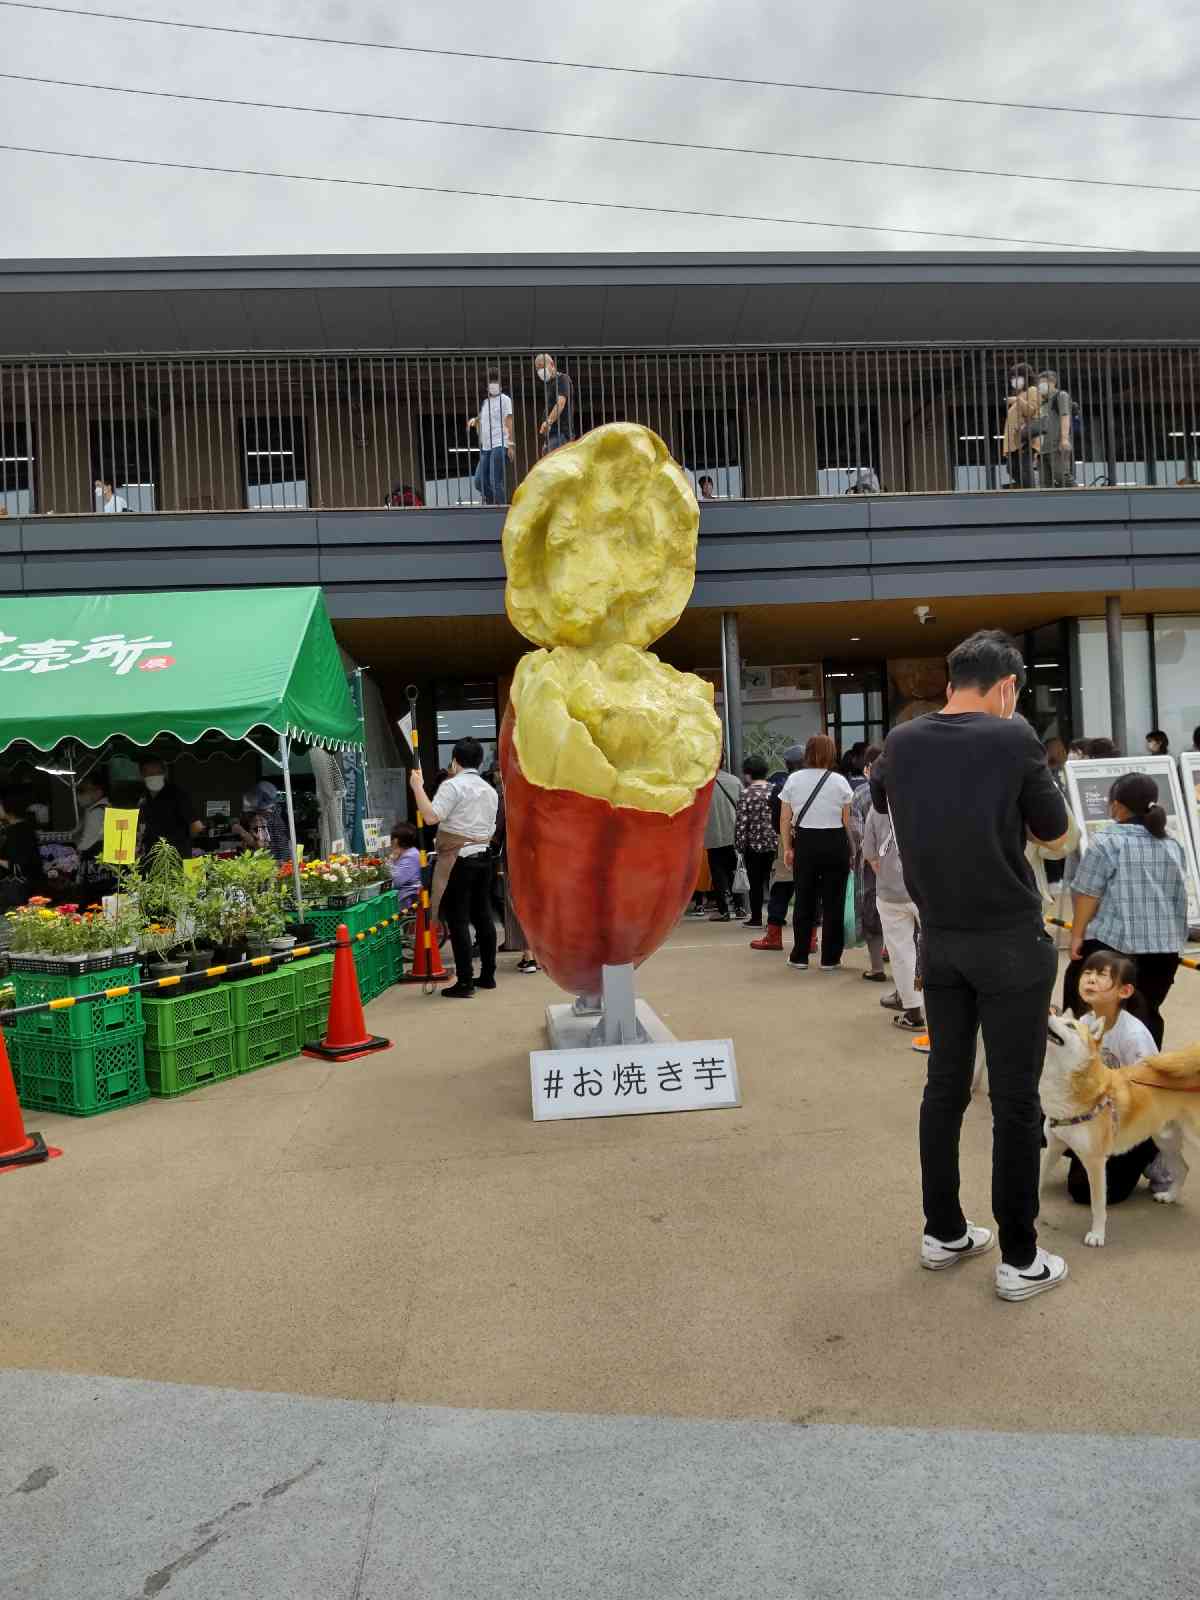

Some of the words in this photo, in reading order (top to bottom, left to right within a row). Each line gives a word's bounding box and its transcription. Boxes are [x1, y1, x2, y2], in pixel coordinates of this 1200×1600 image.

[0, 631, 172, 674] 売所
[543, 1057, 727, 1098] #お焼き芋
